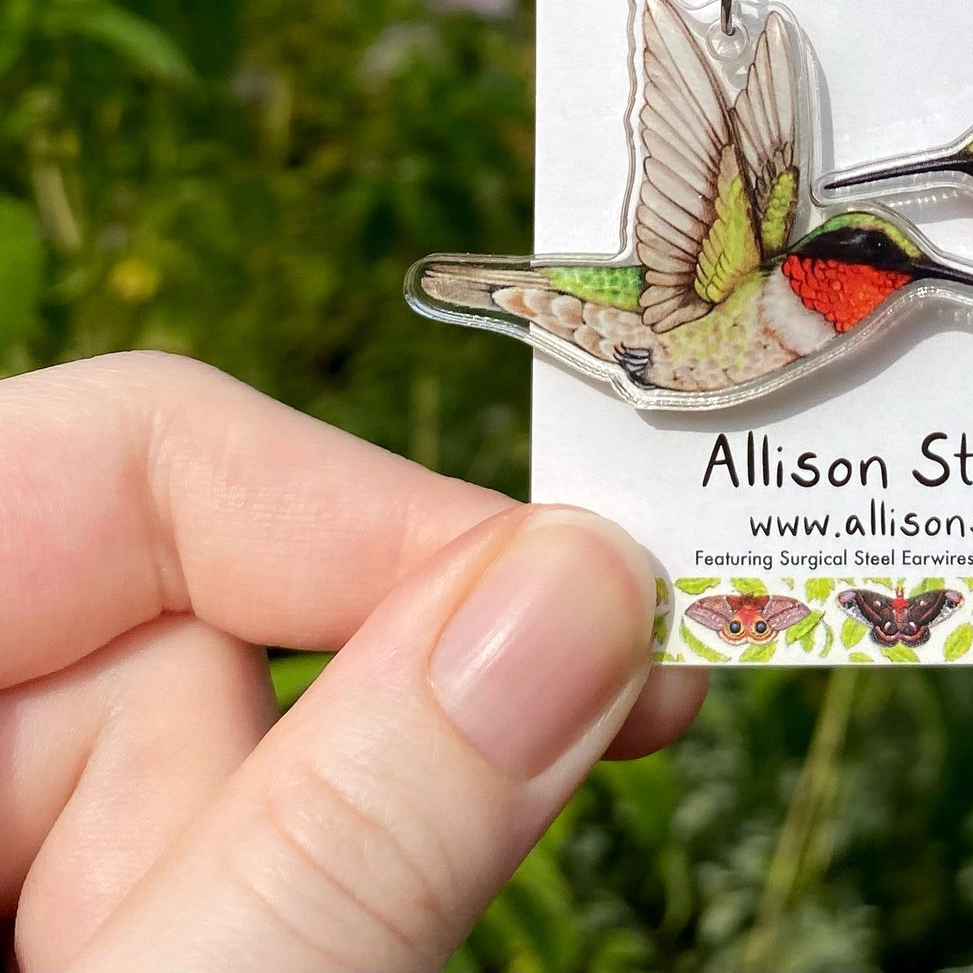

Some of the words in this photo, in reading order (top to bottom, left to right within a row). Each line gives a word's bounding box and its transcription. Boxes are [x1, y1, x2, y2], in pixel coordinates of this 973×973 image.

[701, 430, 888, 489] Allison
[695, 550, 773, 570] Featuring
[780, 549, 848, 570] Surgical
[854, 549, 895, 566] Steel
